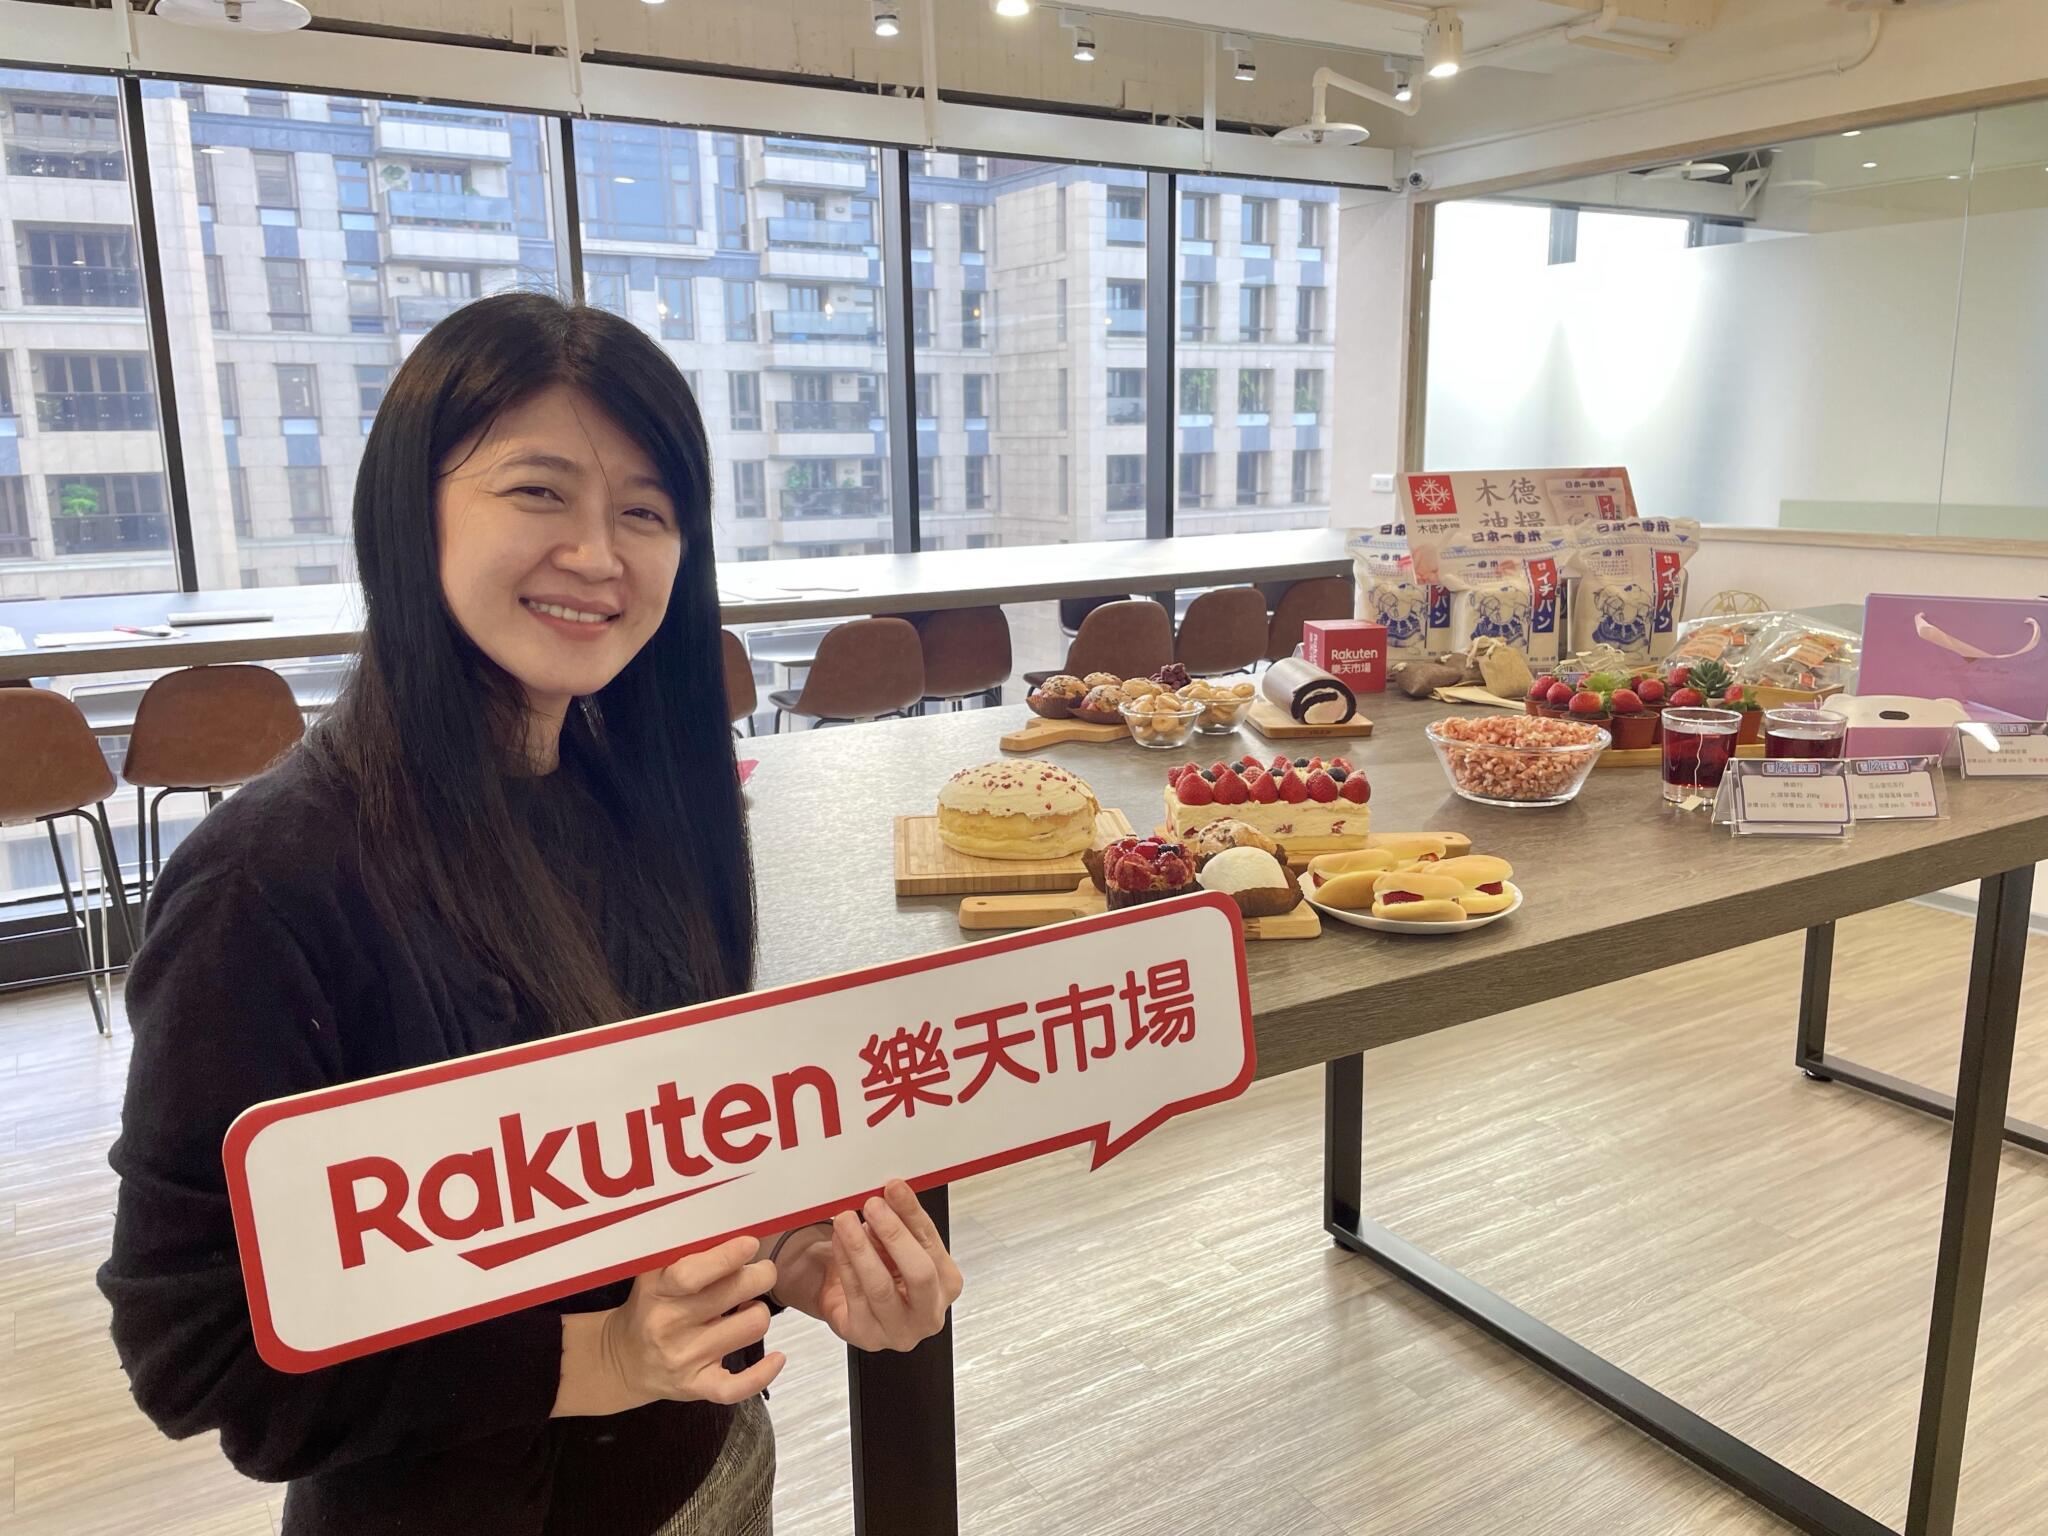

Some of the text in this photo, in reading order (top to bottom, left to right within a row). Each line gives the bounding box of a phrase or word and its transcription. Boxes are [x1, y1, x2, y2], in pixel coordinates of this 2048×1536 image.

[1331, 648, 1379, 660] Rakuten
[1331, 662, 1372, 674] 樂天市場
[327, 959, 1197, 1270] Rakuten 樂天市場
